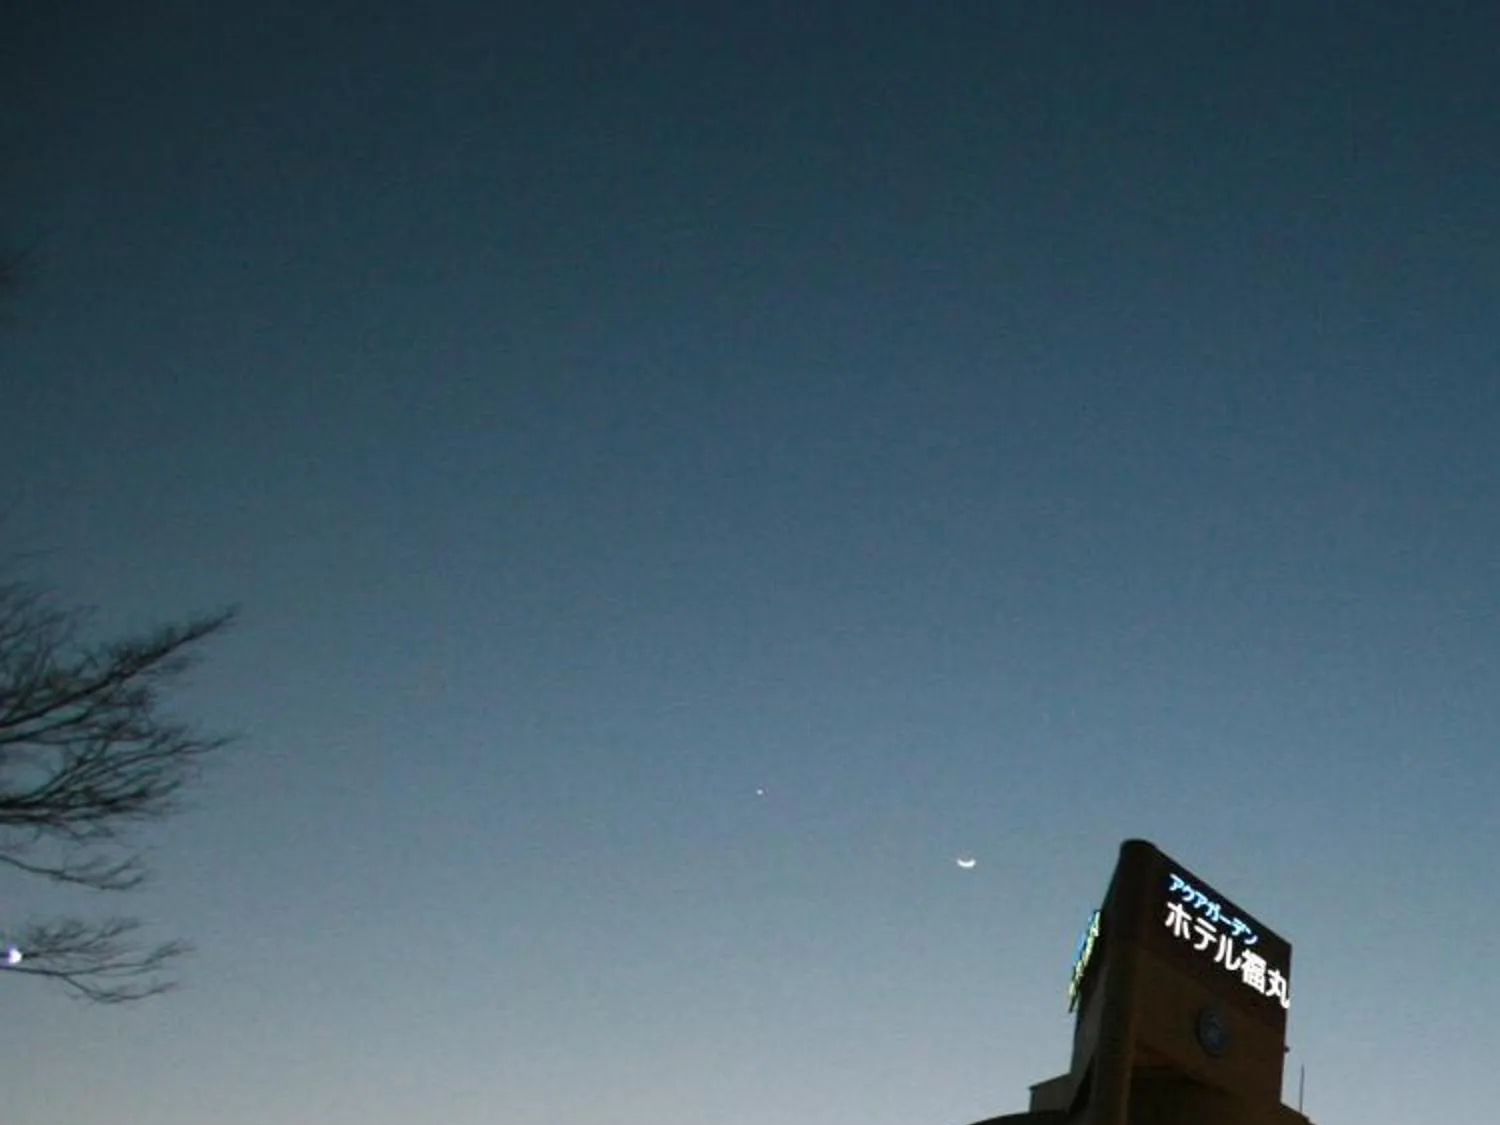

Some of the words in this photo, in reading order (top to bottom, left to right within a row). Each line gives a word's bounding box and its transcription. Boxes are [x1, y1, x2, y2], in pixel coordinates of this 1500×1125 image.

[1168, 873, 1258, 945] アクアガーデン
[1164, 901, 1290, 1009] ホテル福丸
